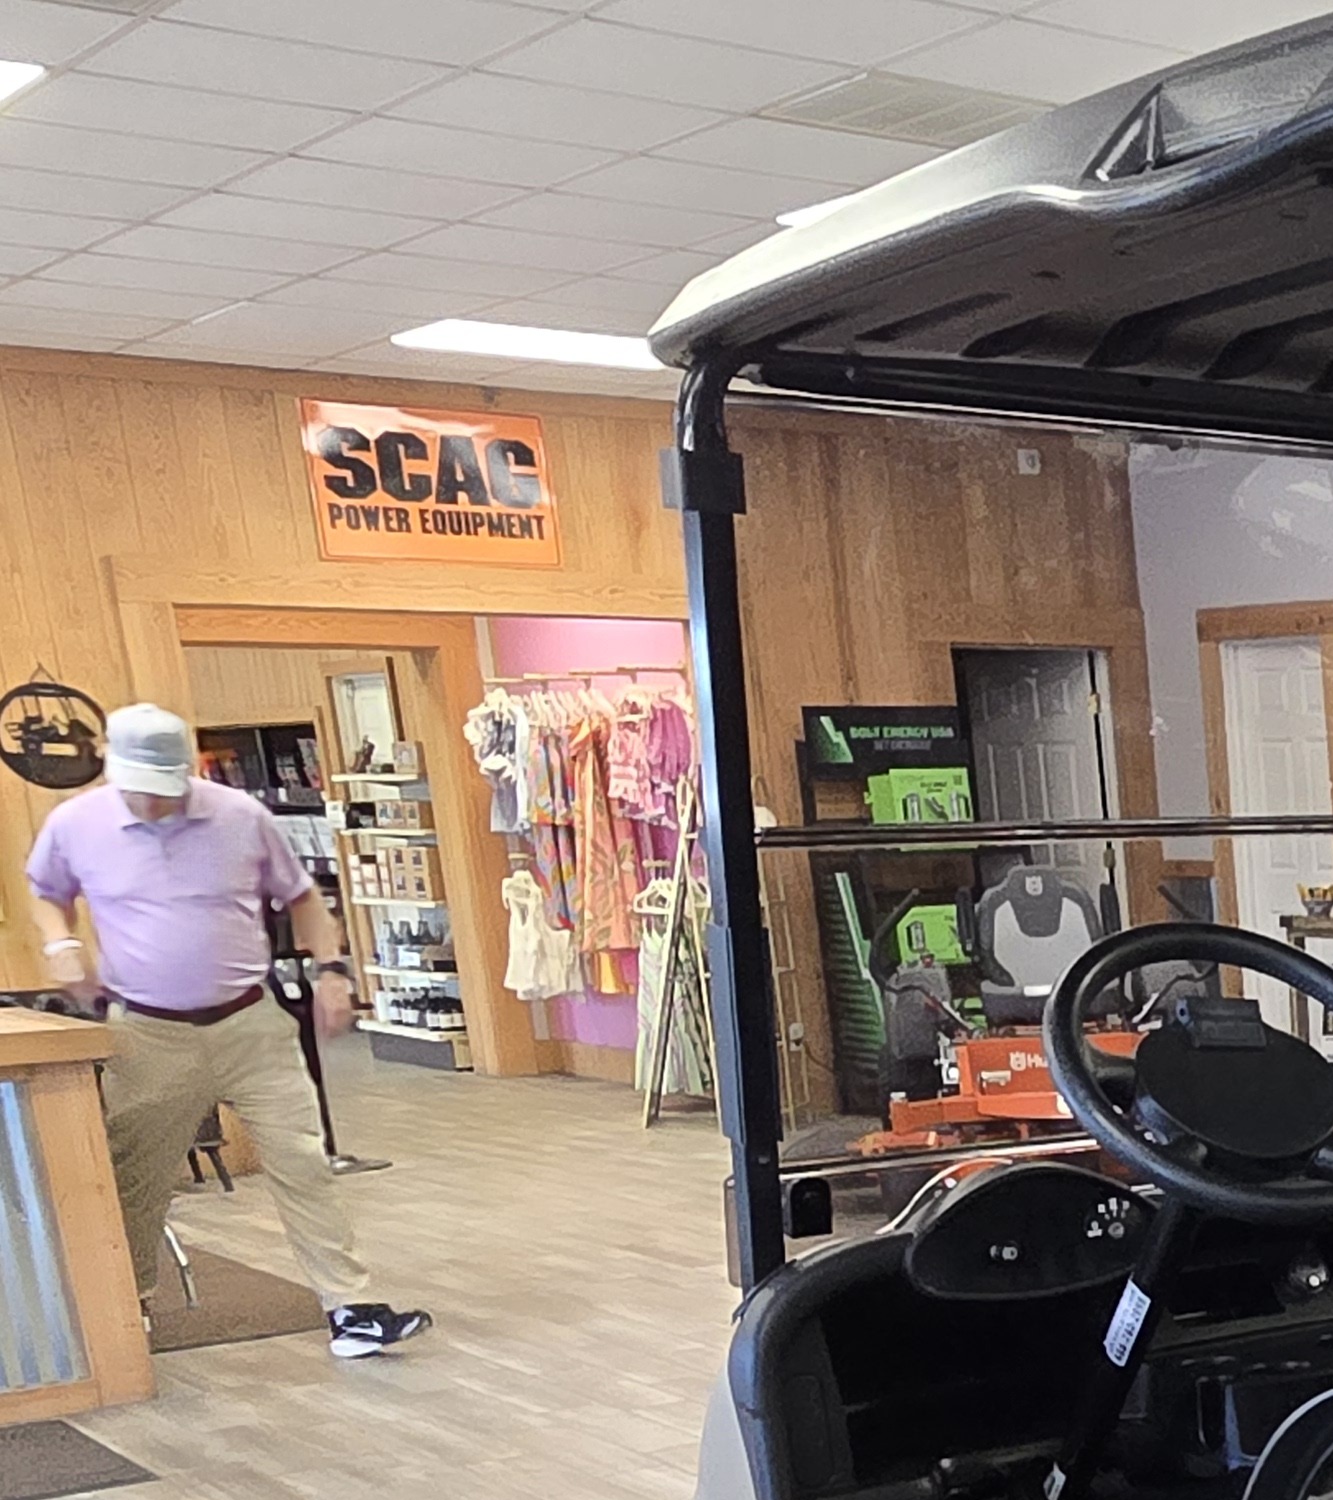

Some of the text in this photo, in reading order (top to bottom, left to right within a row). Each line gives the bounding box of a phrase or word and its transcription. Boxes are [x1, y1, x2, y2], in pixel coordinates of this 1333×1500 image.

[317, 426, 542, 509] SCAG
[328, 502, 546, 540] POWER EQUIPMENT
